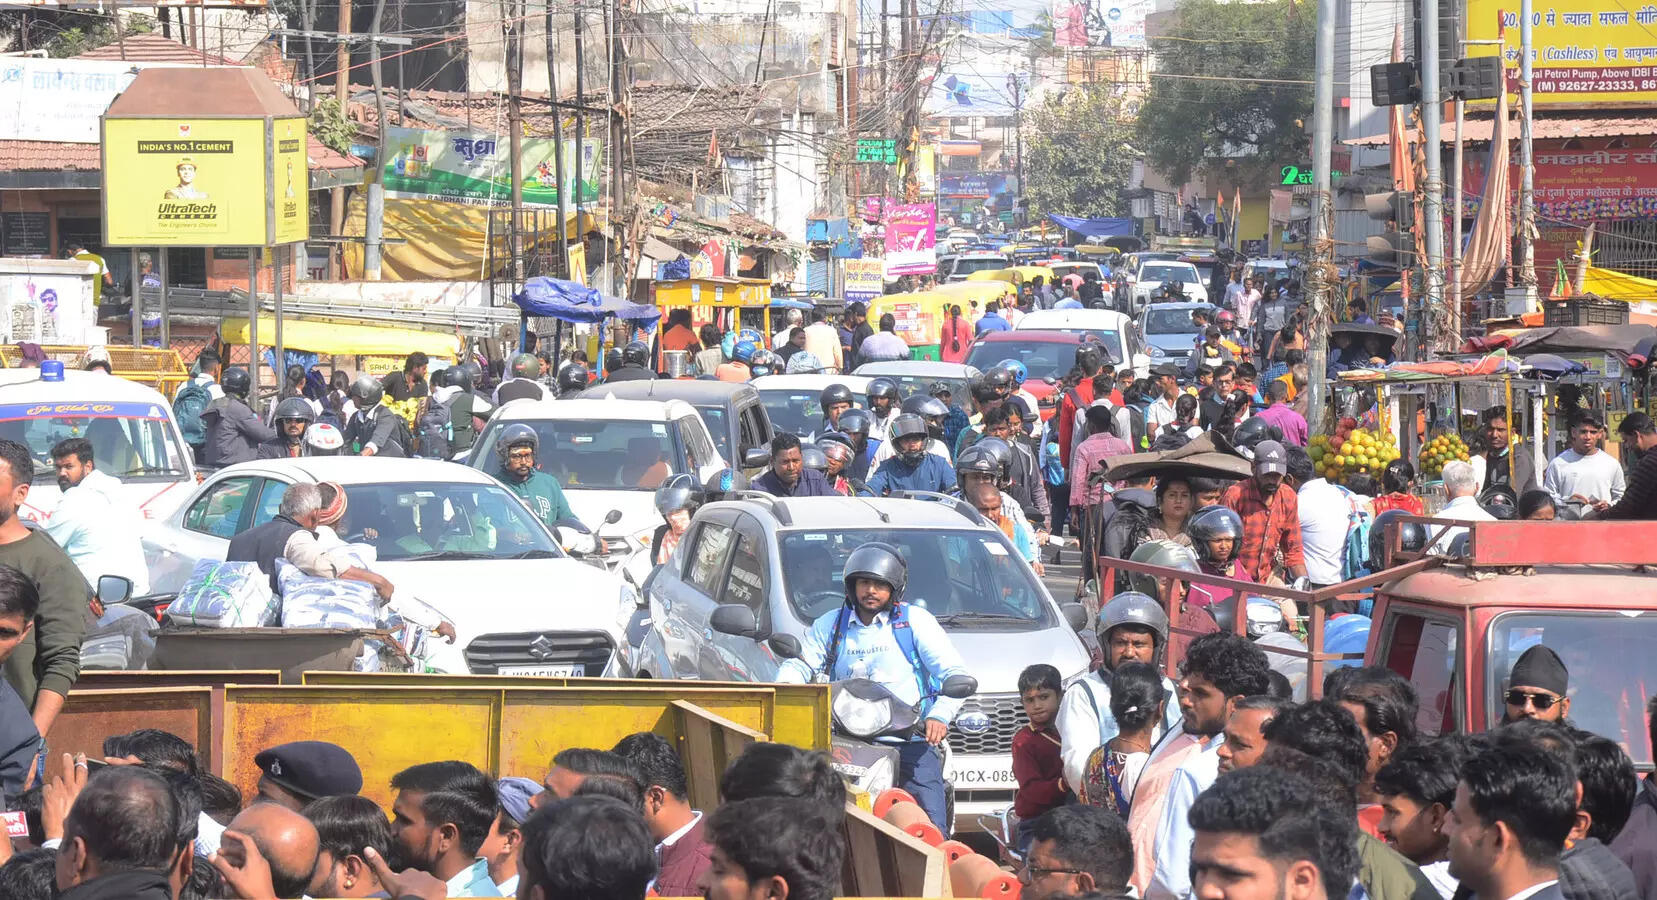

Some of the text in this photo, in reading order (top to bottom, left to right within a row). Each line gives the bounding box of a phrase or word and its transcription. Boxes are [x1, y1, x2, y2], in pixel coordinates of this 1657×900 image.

[1546, 8, 1555, 26] से
[1563, 12, 1592, 25] ज्यादा
[1599, 11, 1628, 25] सफल
[1542, 46, 1599, 62] (Cashless)
[1544, 69, 1570, 79] Petrol
[1572, 69, 1600, 80] Pump,
[1602, 69, 1629, 78] Above
[1631, 68, 1650, 77] IDBI
[1537, 81, 1556, 92] (M)
[1559, 80, 1638, 92] 92627-23333,
[140, 142, 231, 151] INDIA'S NO.1 CEMENT
[452, 138, 496, 161] सुधा
[1536, 150, 1629, 165] महावीर
[1281, 165, 1298, 184] 2
[158, 203, 217, 213] UltraTech
[472, 199, 489, 207] PAN
[846, 646, 890, 655] EXHAUSTED
